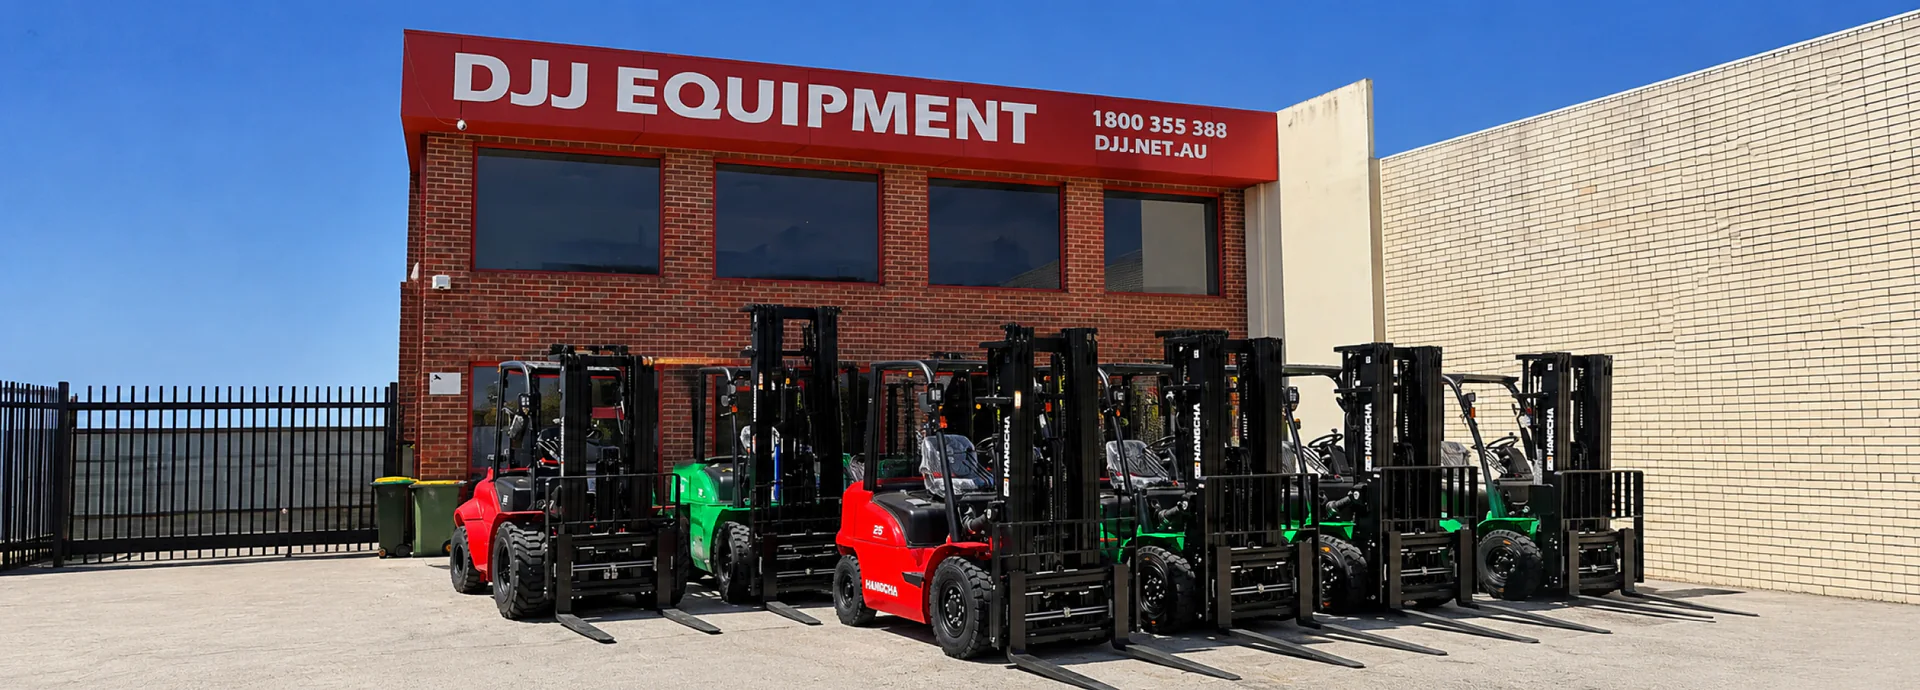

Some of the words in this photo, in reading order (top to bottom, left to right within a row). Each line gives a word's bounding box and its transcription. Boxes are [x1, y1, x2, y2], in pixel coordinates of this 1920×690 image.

[453, 53, 589, 109] DJJ
[616, 67, 1037, 144] EQUIPMENT
[1092, 110, 1144, 131] 1800
[1149, 116, 1186, 135] 355
[1192, 120, 1228, 138] 388
[1094, 134, 1207, 160] DJJ.NET.AU
[1193, 402, 1201, 461] HANGCHA
[1364, 402, 1372, 455] HANGCHA
[872, 524, 884, 536] 25
